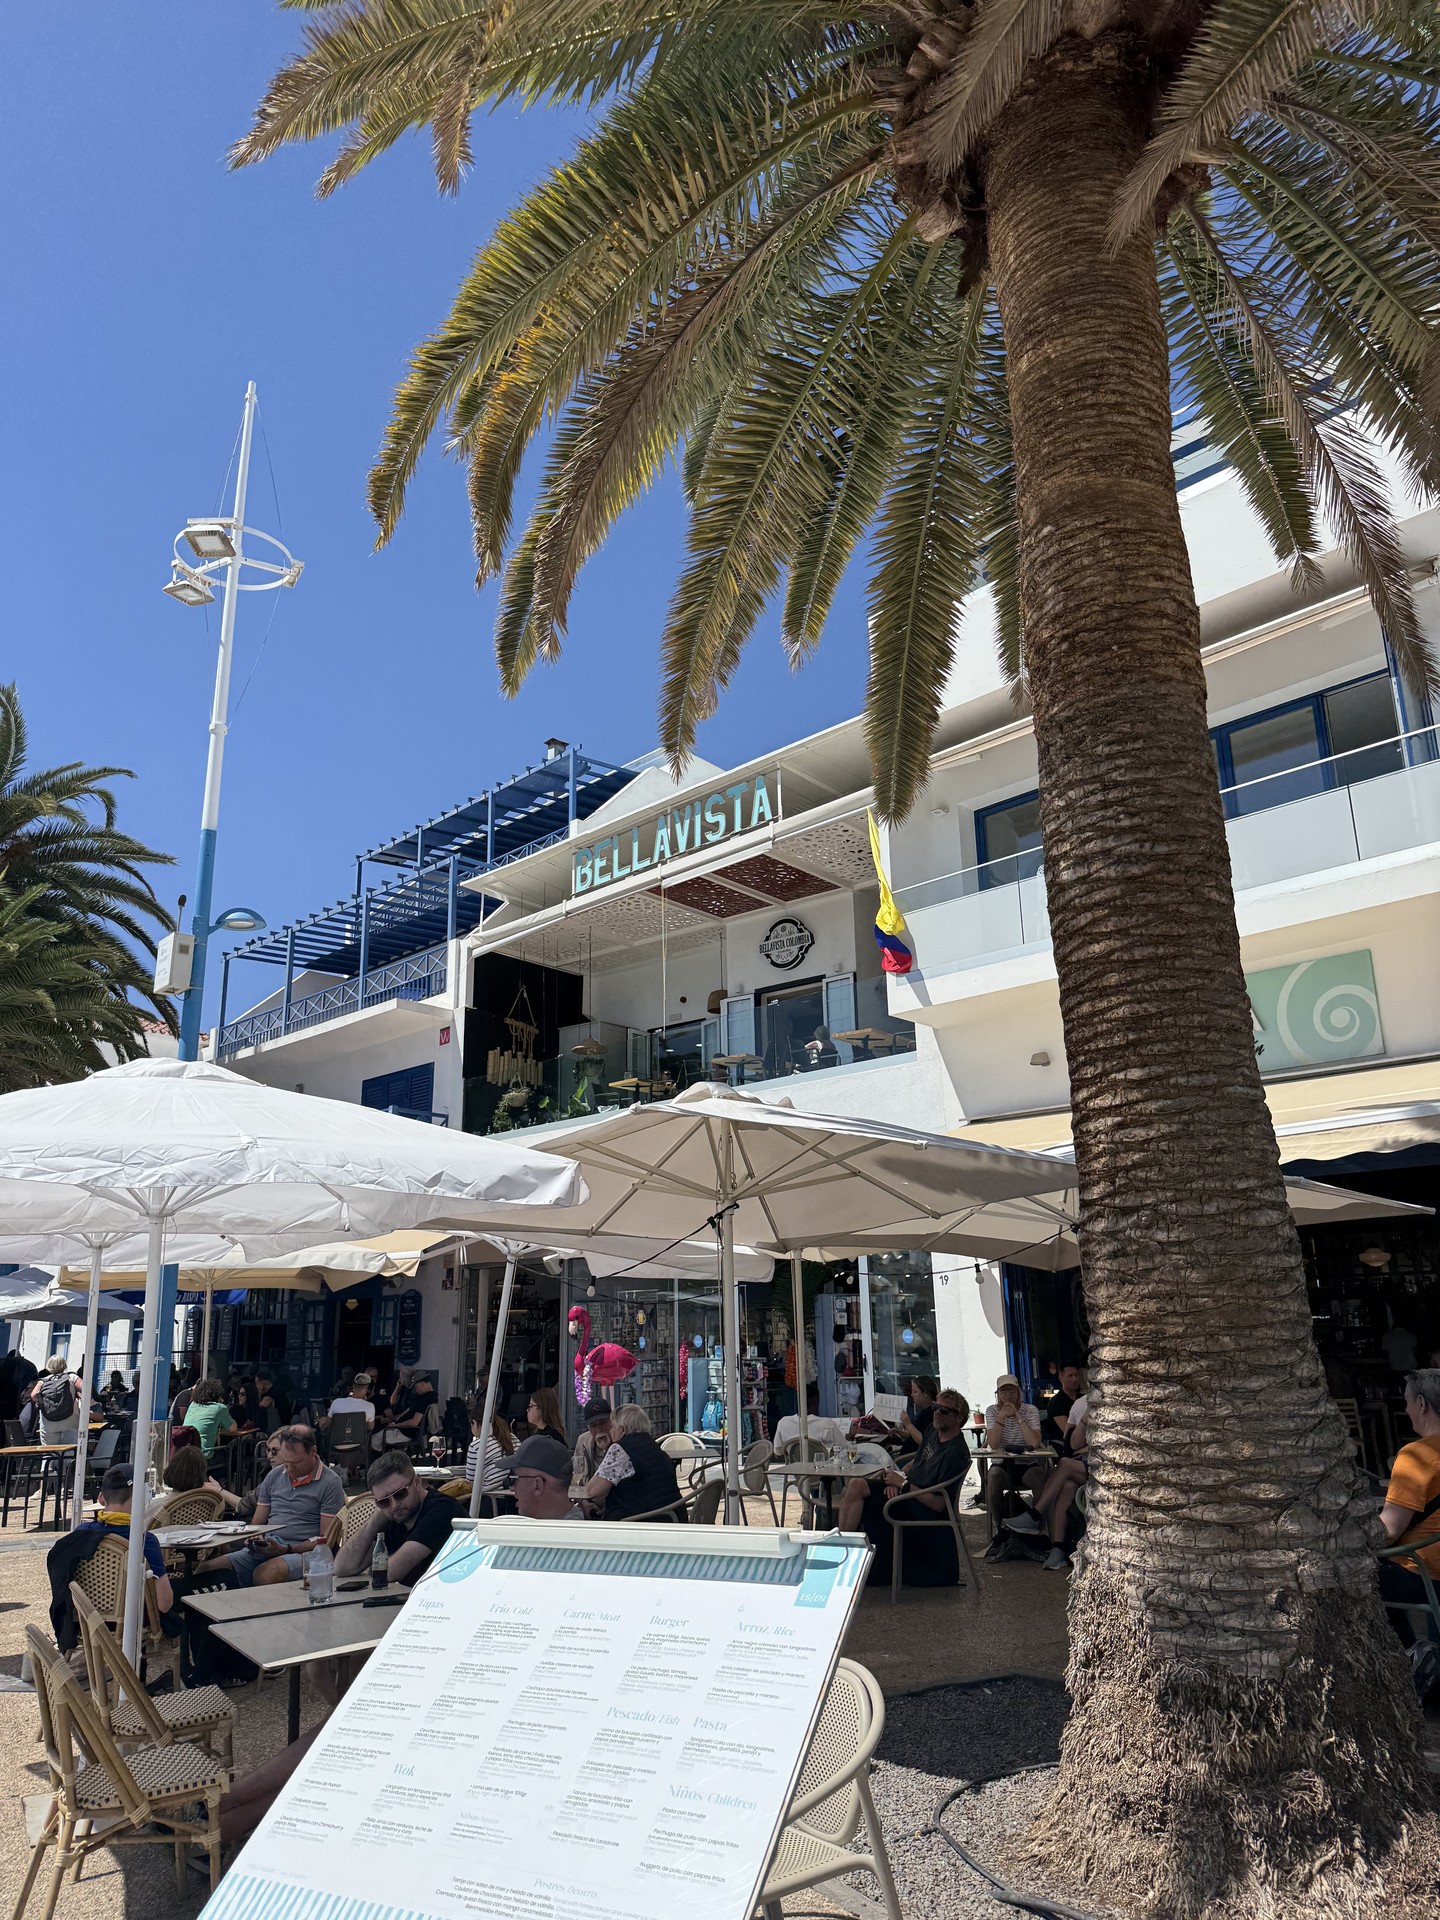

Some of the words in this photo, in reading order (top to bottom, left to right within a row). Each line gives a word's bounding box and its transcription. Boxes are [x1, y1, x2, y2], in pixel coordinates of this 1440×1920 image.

[575, 776, 773, 893] BELLAVISTA
[759, 939, 786, 955] BELLAVISTA
[785, 933, 810, 948] COLOMBIA
[939, 1275, 950, 1286] 19
[418, 1598, 445, 1611] Tapas
[800, 1592, 826, 1603] ES/EN
[649, 1615, 690, 1629] Burger
[693, 1716, 728, 1732] Pasta
[392, 1763, 416, 1777] Wok
[669, 1784, 704, 1801] Niños
